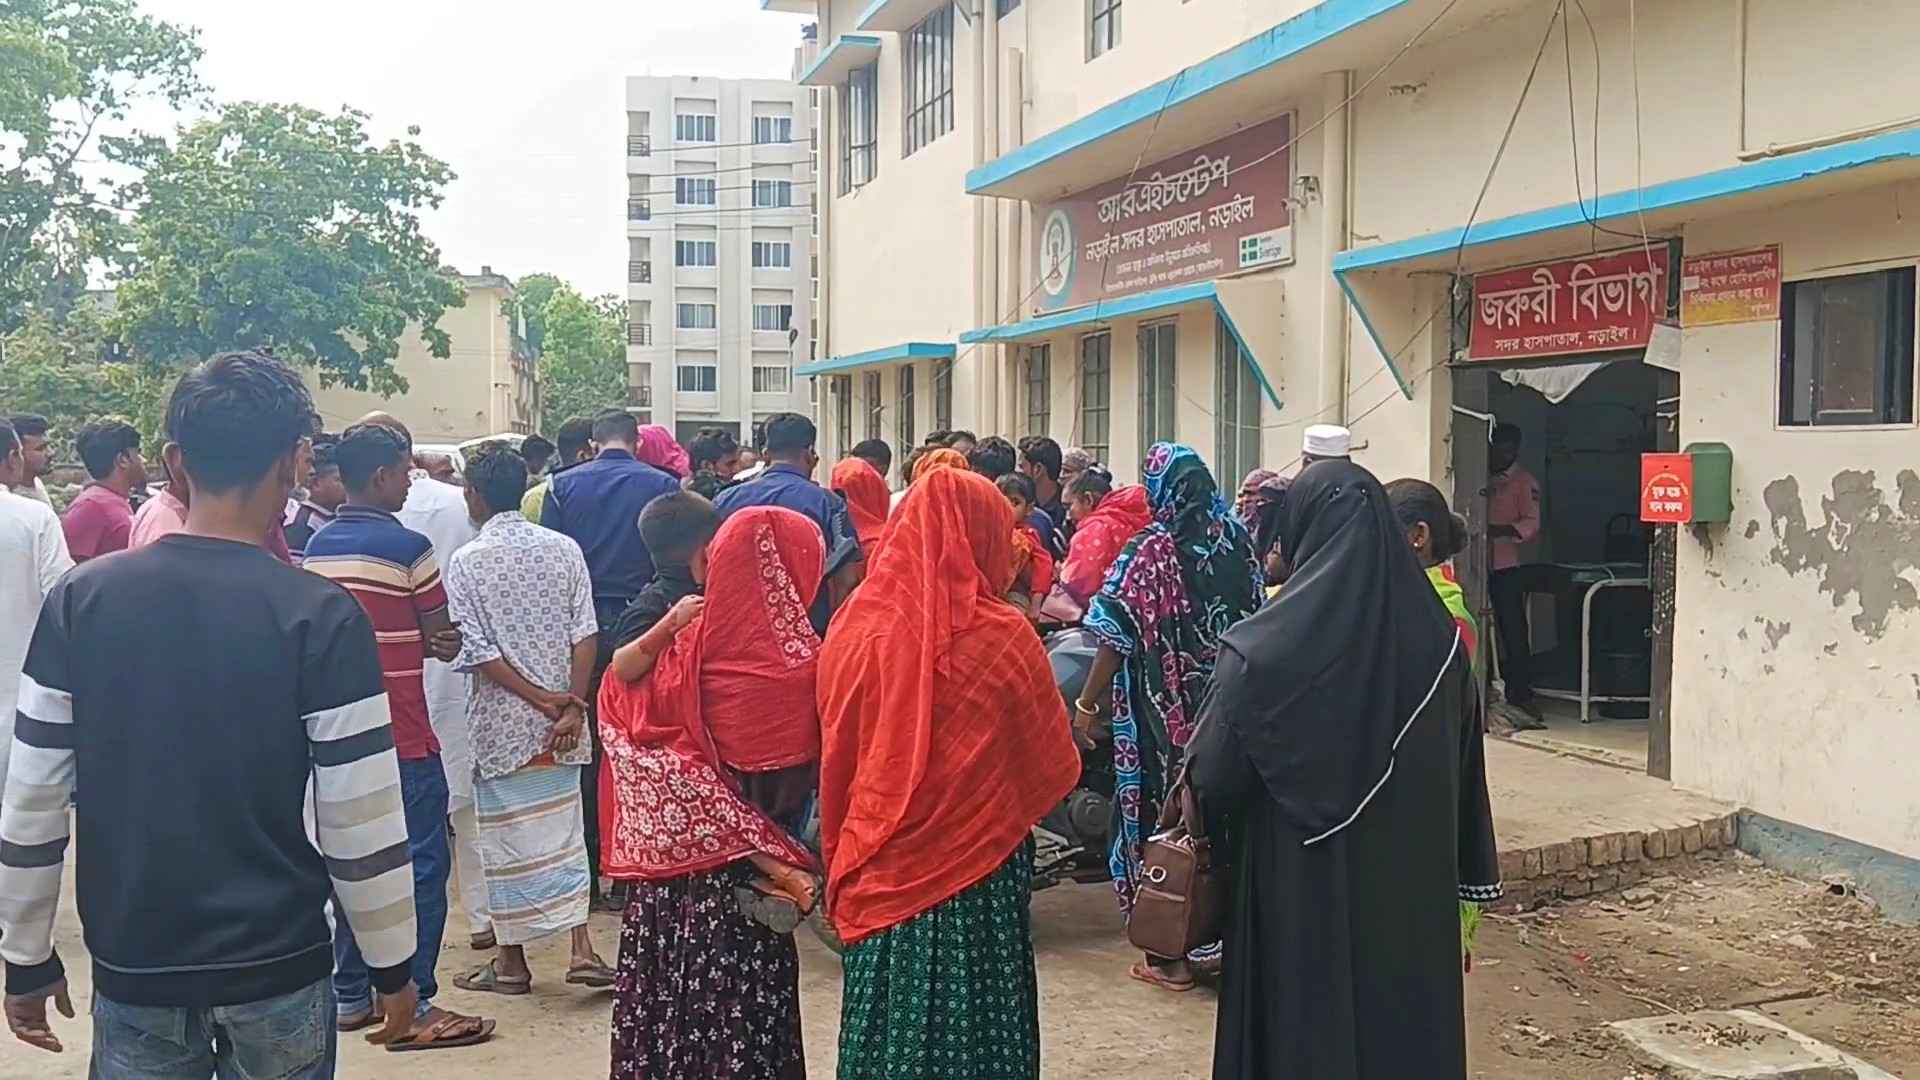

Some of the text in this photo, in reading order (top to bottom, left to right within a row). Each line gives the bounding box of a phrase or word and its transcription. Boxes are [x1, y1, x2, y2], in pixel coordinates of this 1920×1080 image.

[1121, 228, 1145, 251] সদর
[1147, 211, 1206, 245] হাসপাতাল,
[1208, 194, 1255, 229] নড়াইল
[1478, 262, 1664, 330] জরুরী বিভাগ
[1495, 338, 1520, 352] সদর
[1523, 331, 1584, 350] হাসপাতাল,
